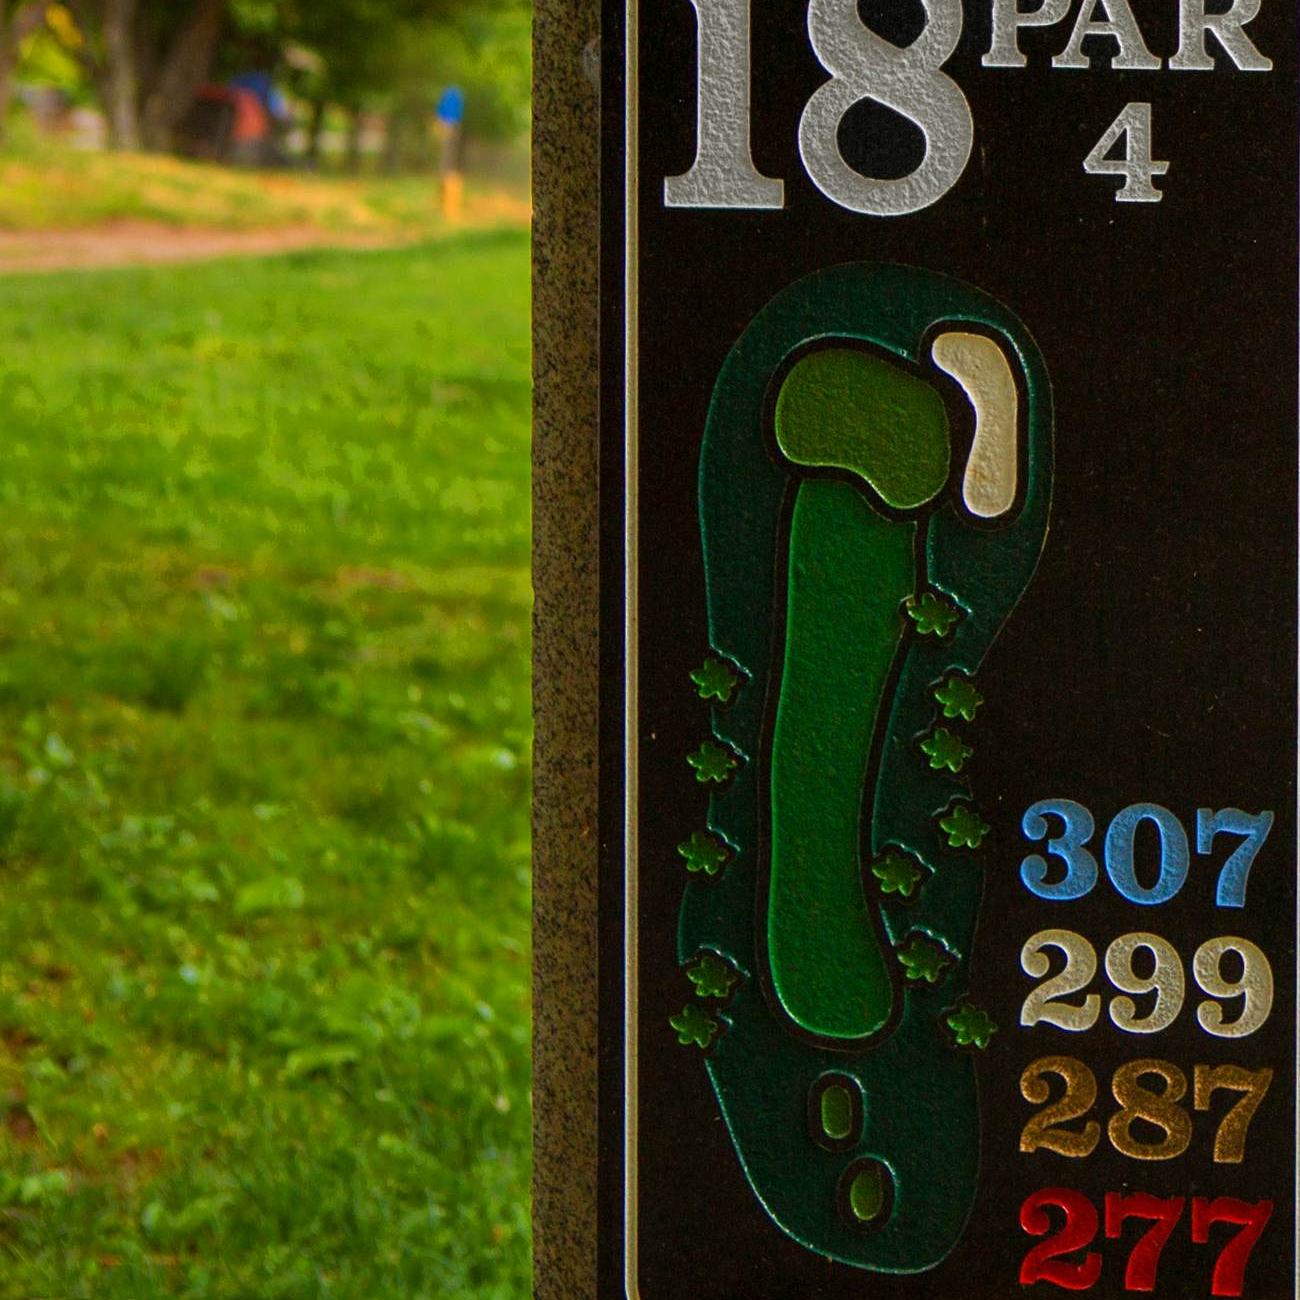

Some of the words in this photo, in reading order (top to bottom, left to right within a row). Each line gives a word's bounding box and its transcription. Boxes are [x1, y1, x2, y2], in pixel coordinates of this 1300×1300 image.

[1083, 101, 1170, 202] 4
[1020, 798, 1274, 908] 307
[1020, 929, 1274, 1038] 299
[1019, 1055, 1274, 1164] 287
[1019, 1187, 1274, 1297] 277
